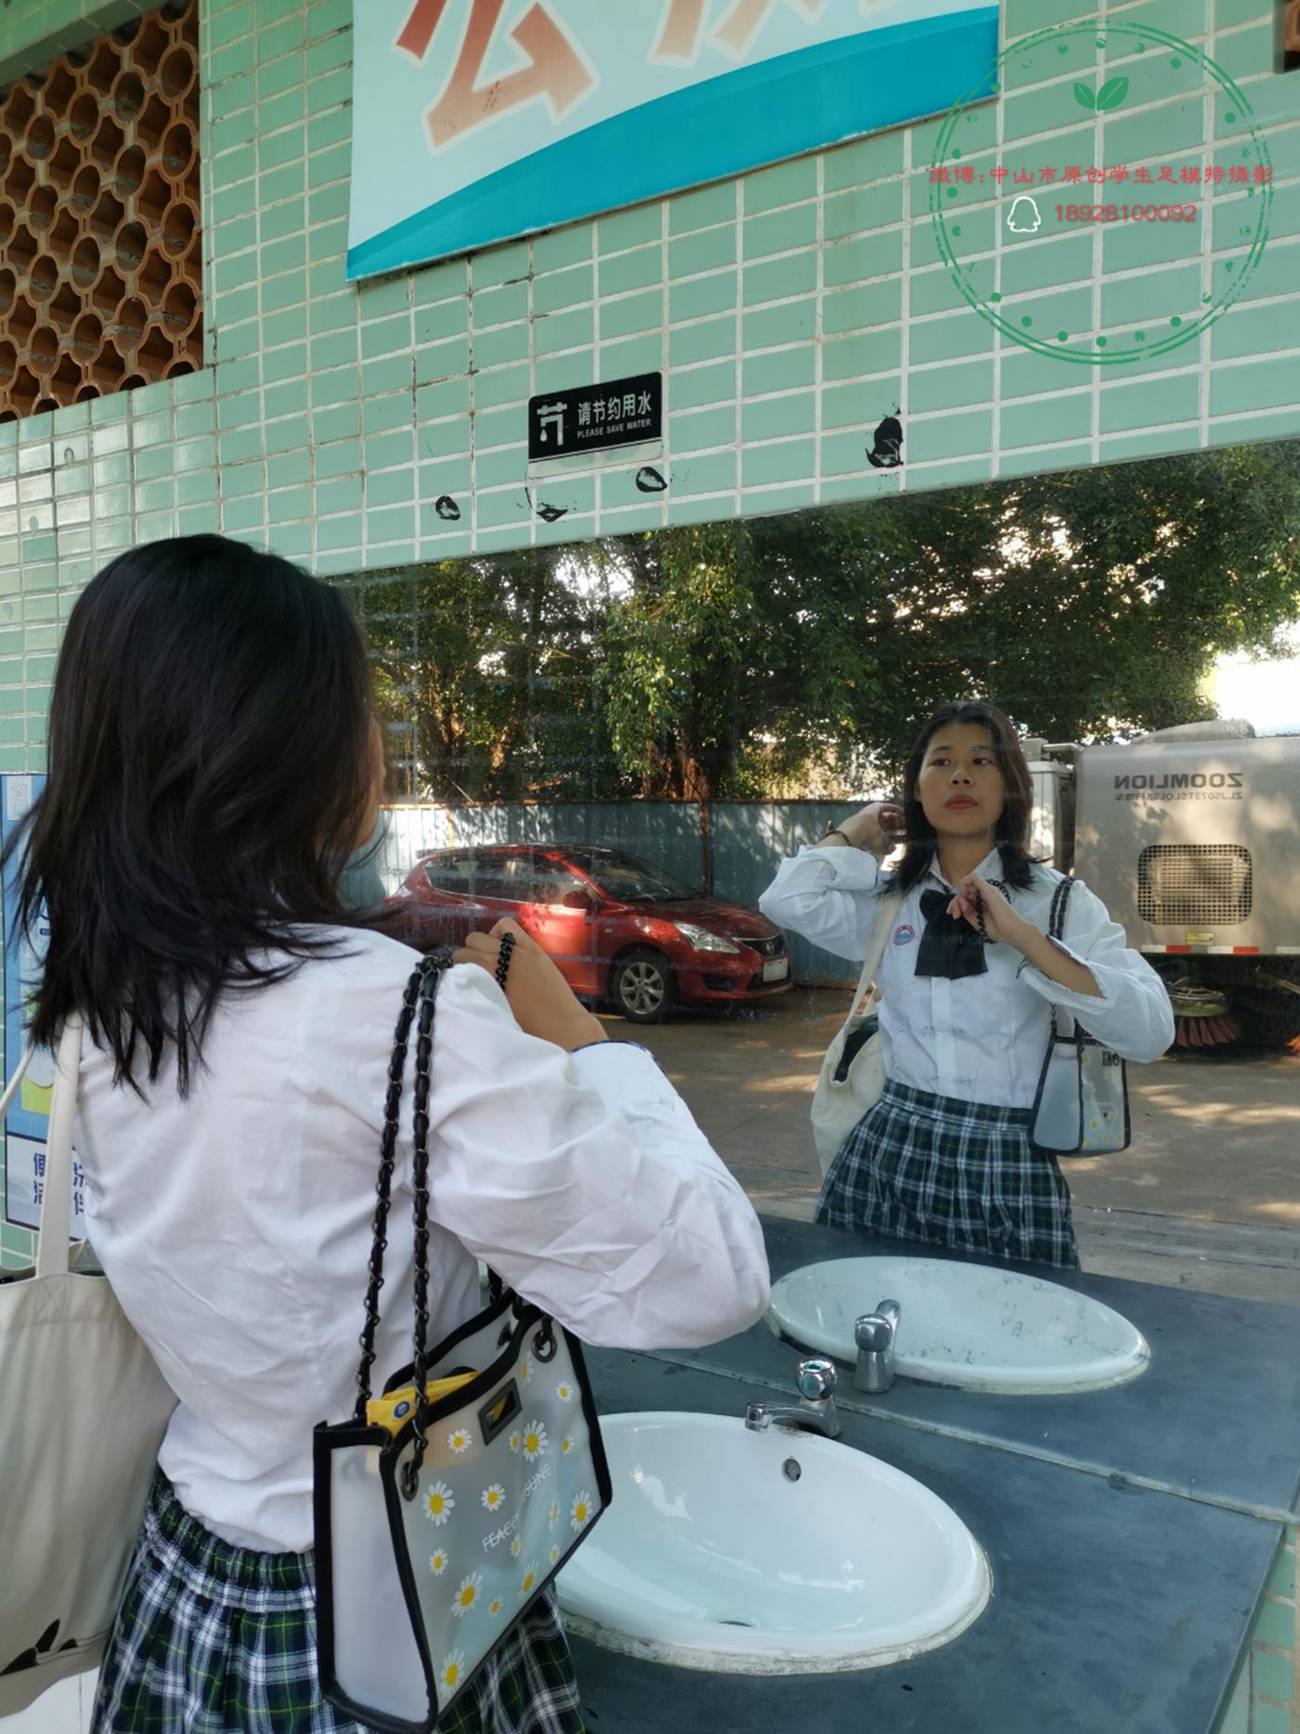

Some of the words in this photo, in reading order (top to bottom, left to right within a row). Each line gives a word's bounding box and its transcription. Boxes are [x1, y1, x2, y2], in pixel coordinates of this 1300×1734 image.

[577, 390, 652, 426] 请节约用水
[577, 426, 604, 439] PLEASE
[606, 423, 624, 434] SAVE
[627, 418, 651, 431] WATER
